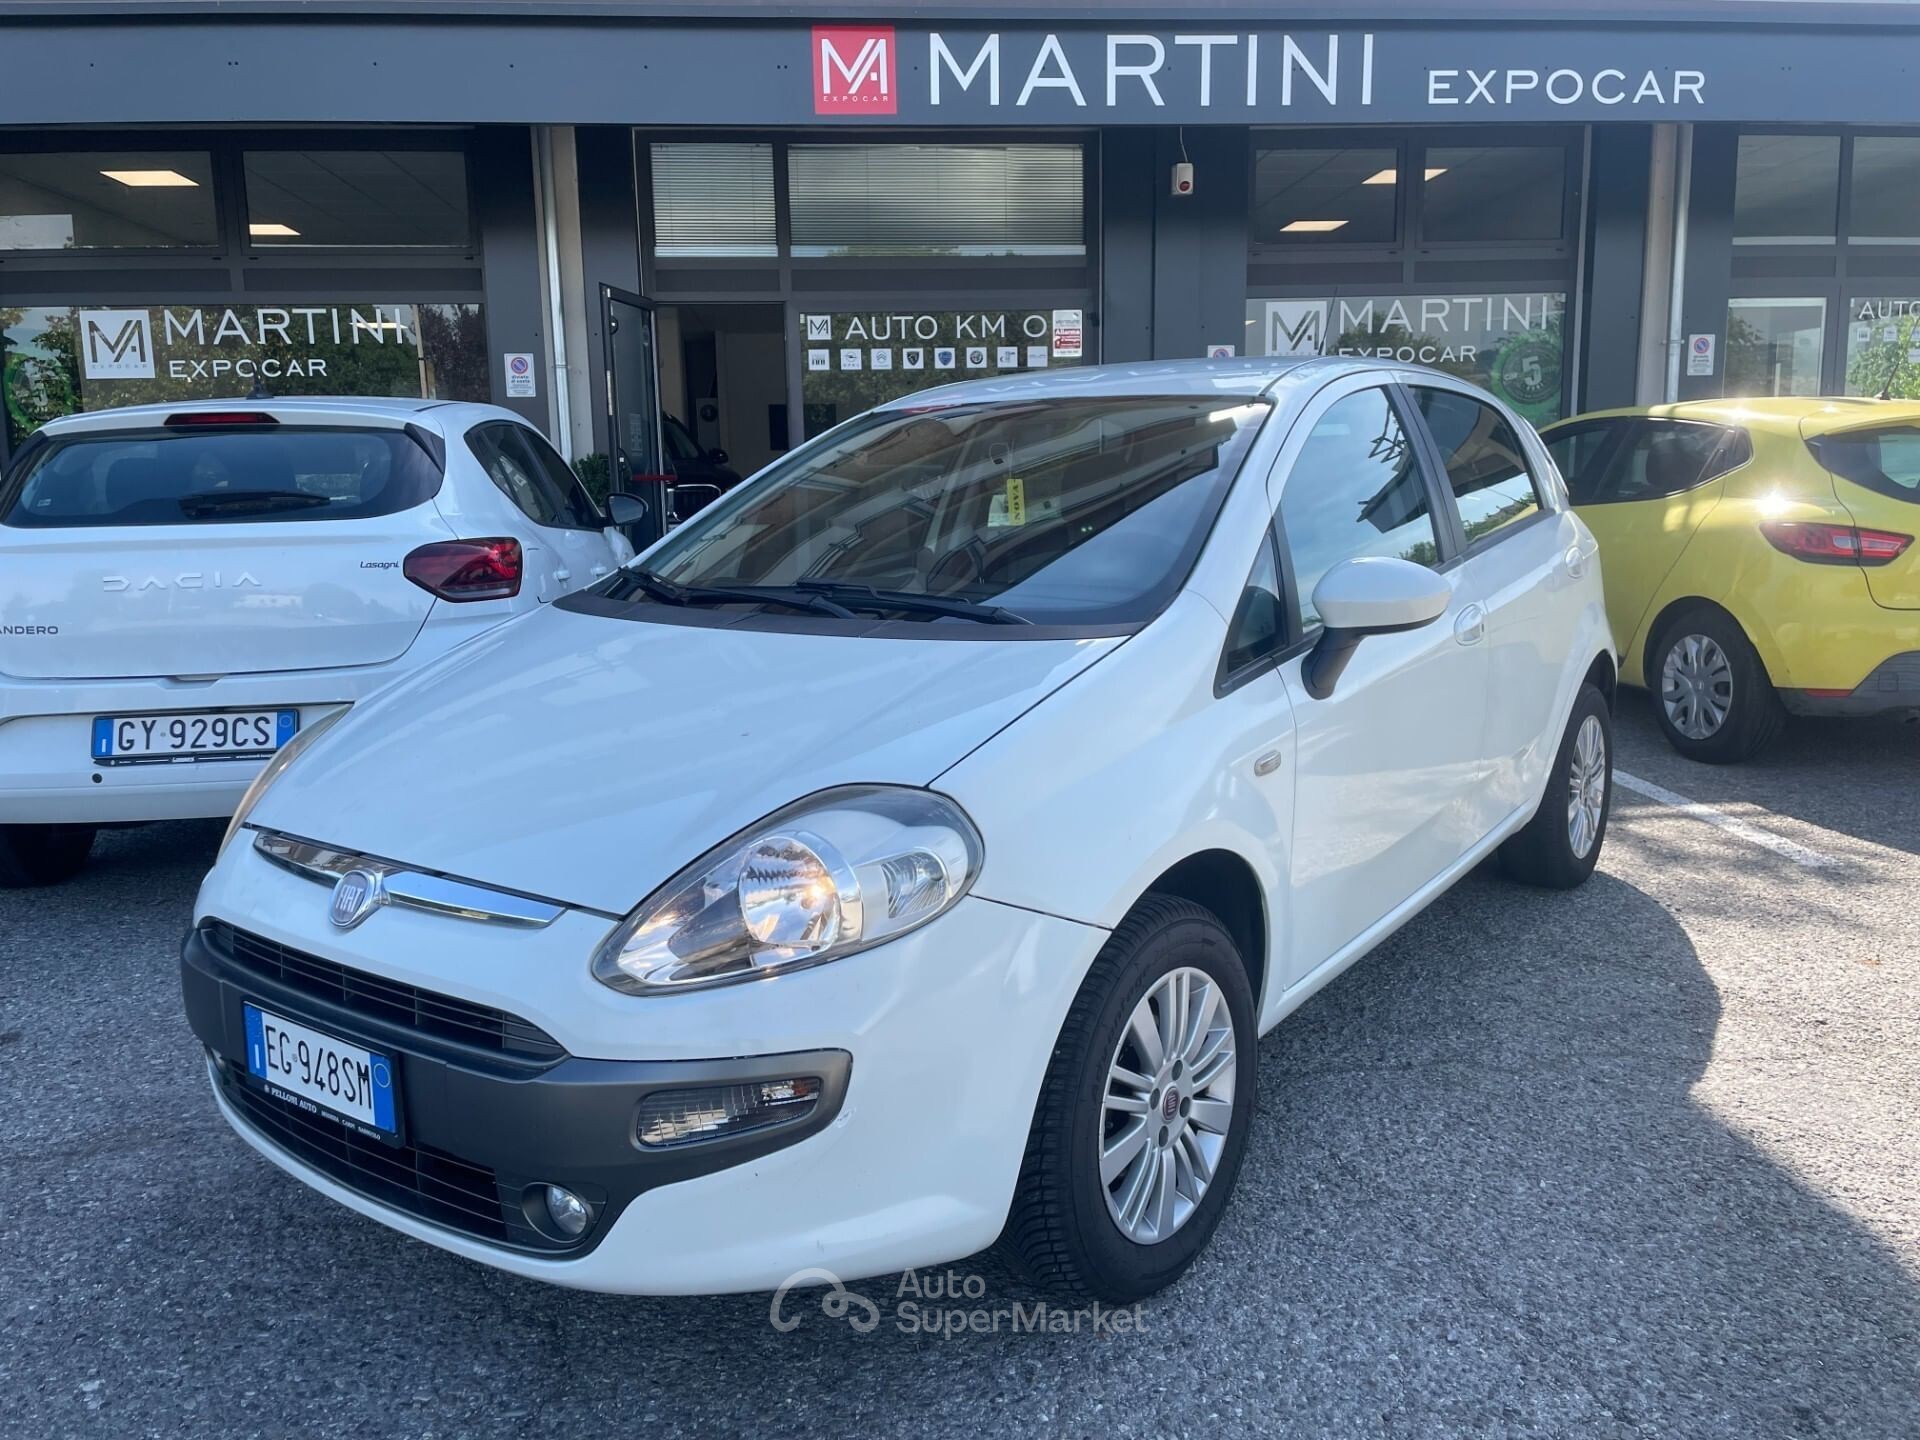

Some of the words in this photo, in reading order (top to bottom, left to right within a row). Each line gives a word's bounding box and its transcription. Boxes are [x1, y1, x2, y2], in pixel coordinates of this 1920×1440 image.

[929, 32, 1374, 107] MARTINI
[1427, 68, 1706, 105] EXPOCAR
[163, 307, 404, 346] MARTINI
[844, 315, 939, 340] AUTO
[955, 314, 1005, 338] KM
[1339, 296, 1549, 335] MARTINI
[1338, 345, 1477, 364] EXPOCAR
[168, 359, 329, 379] EXPOCAR
[102, 571, 263, 593] DACIA
